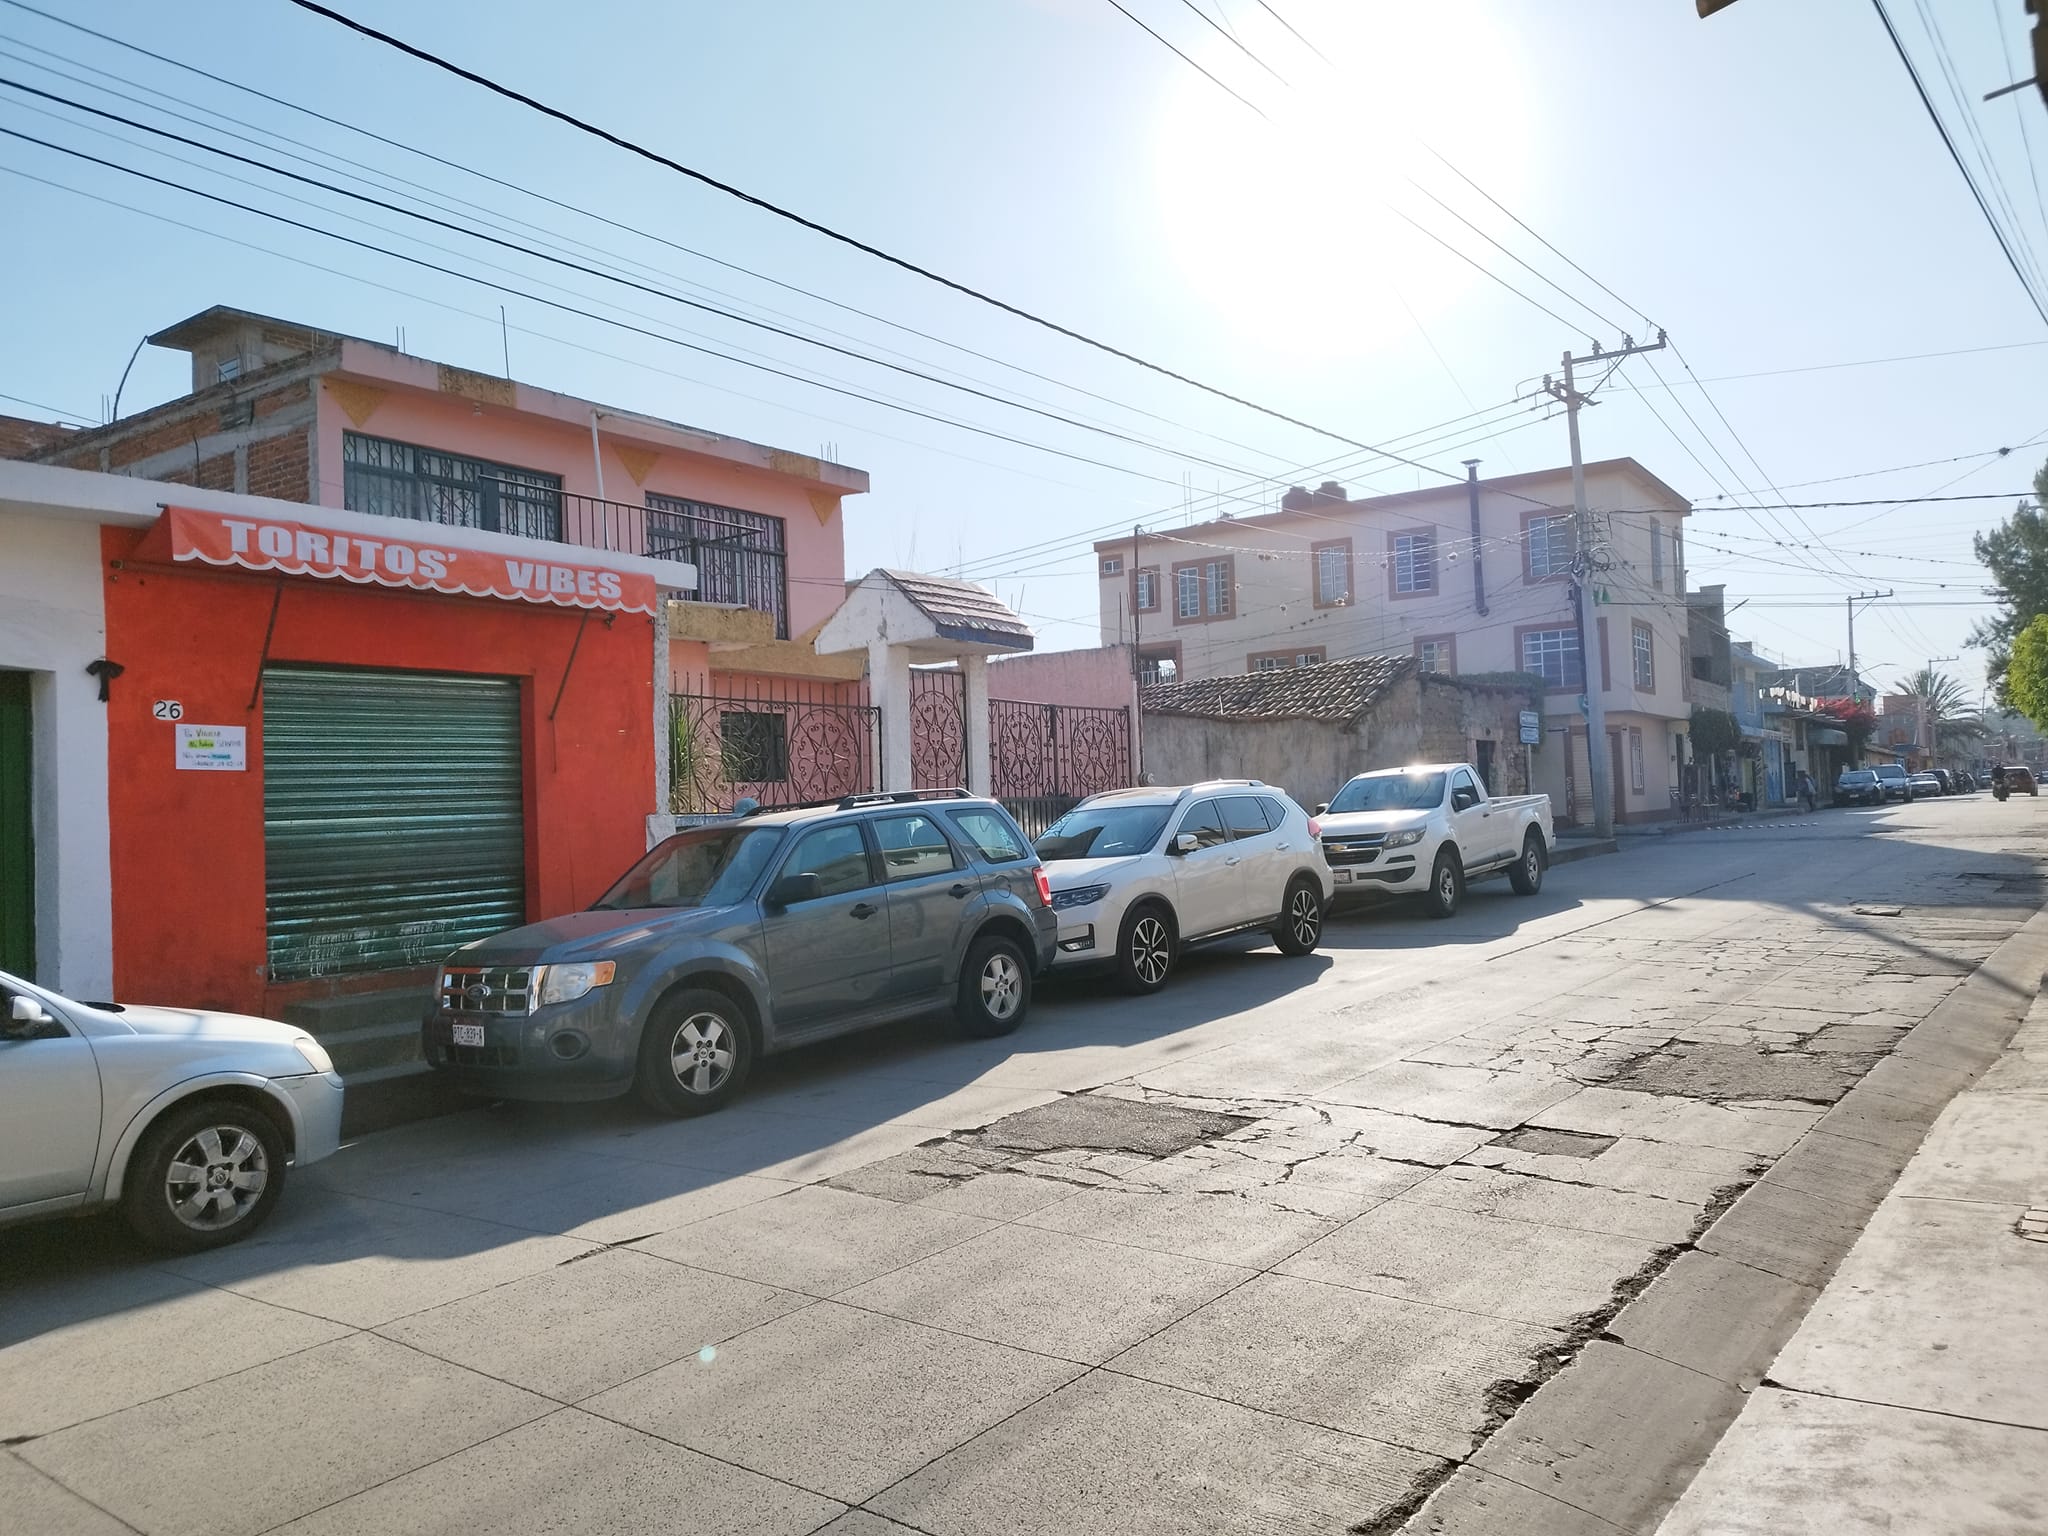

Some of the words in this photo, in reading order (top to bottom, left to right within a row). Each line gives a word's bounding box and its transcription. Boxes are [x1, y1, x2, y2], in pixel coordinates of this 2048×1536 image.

[221, 519, 456, 579] TORITOS'
[505, 560, 622, 600] VIBES
[155, 700, 181, 719] 26
